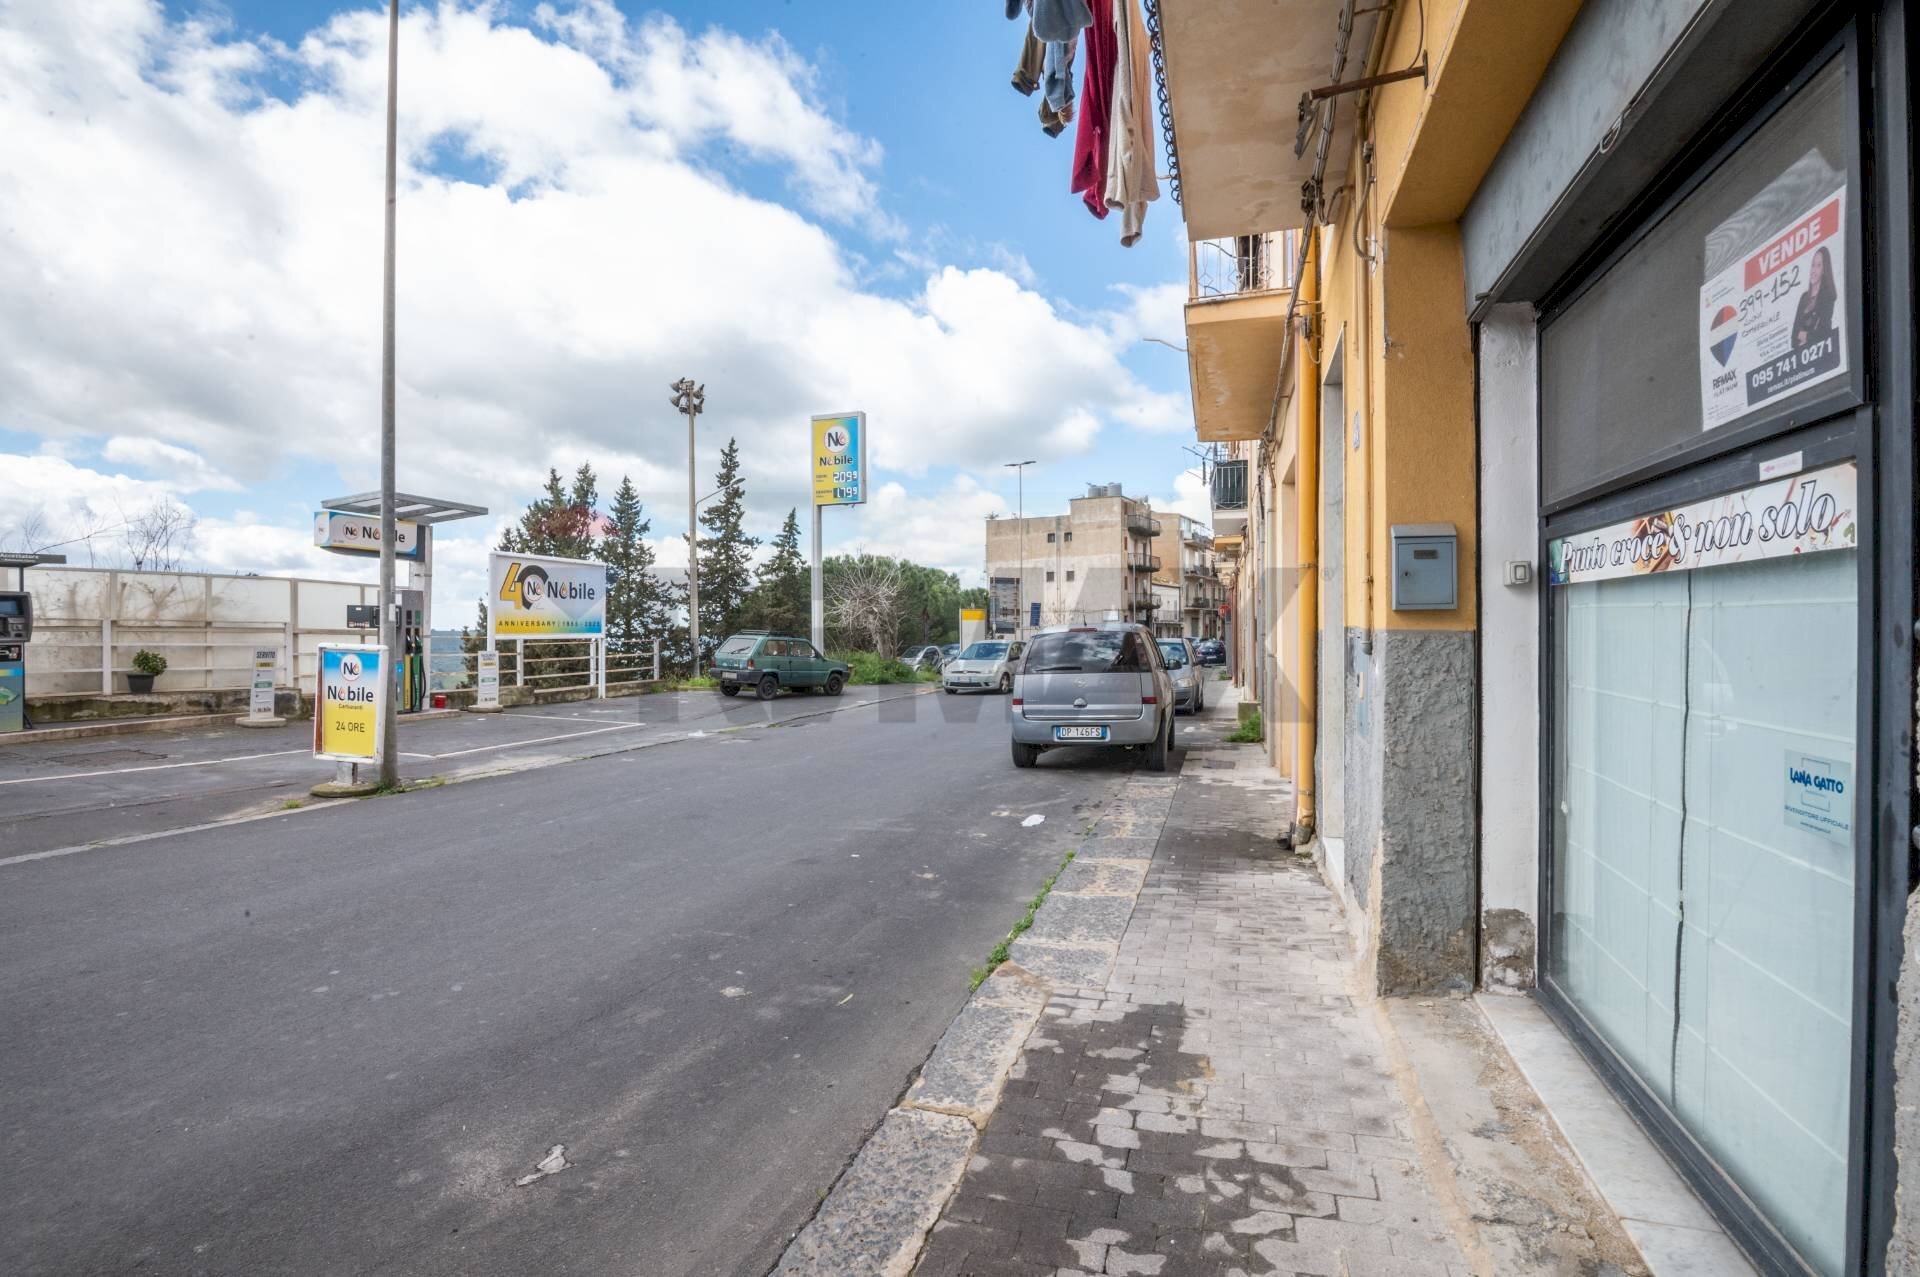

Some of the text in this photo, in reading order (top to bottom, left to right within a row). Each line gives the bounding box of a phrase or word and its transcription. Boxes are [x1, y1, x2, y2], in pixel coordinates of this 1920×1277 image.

[1758, 216, 1822, 275] VENDE
[1738, 264, 1802, 322] 399-152
[1752, 366, 1774, 387] 095
[1776, 355, 1797, 377] 741
[1801, 337, 1833, 365] 0271
[1712, 368, 1737, 390] REMAX
[819, 455, 853, 466] Nobile
[362, 526, 406, 542] Nole
[1558, 480, 1836, 575] Punto croce & non solo
[547, 580, 595, 599] Nobile
[327, 685, 374, 702] Nobile
[336, 721, 366, 733] 24 ORE
[1789, 767, 1812, 787] LANA
[1813, 775, 1844, 794] GATTO
